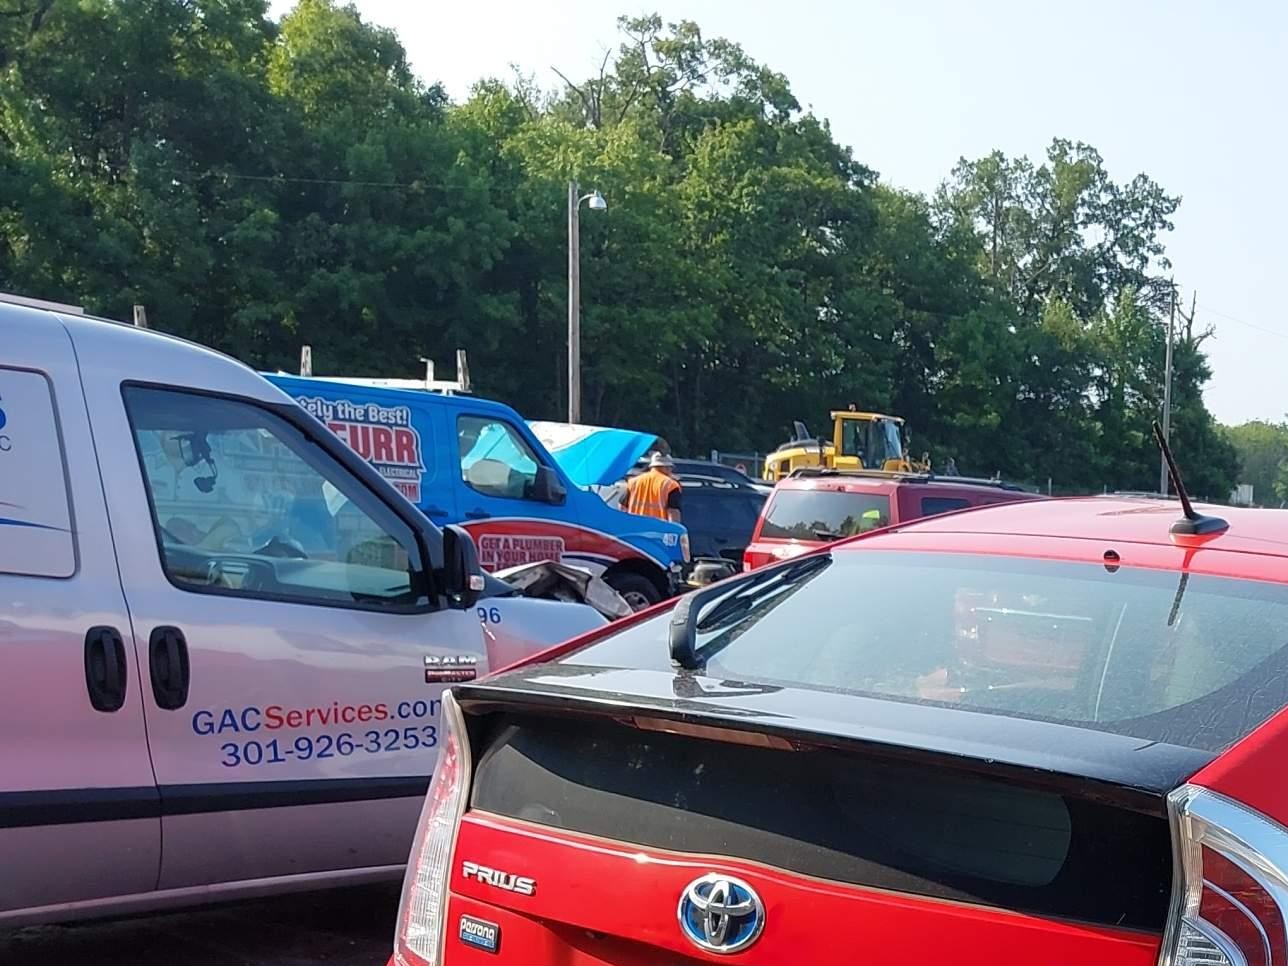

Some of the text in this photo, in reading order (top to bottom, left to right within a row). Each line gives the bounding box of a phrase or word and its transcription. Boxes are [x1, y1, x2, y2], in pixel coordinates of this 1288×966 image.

[337, 403, 364, 420] the
[368, 406, 407, 424] Best!
[481, 537, 563, 551] GET A PLUMBER
[481, 551, 562, 563] IN YOUR HOME
[220, 725, 438, 767] 301-926-3253
[462, 861, 536, 895] PRIUS
